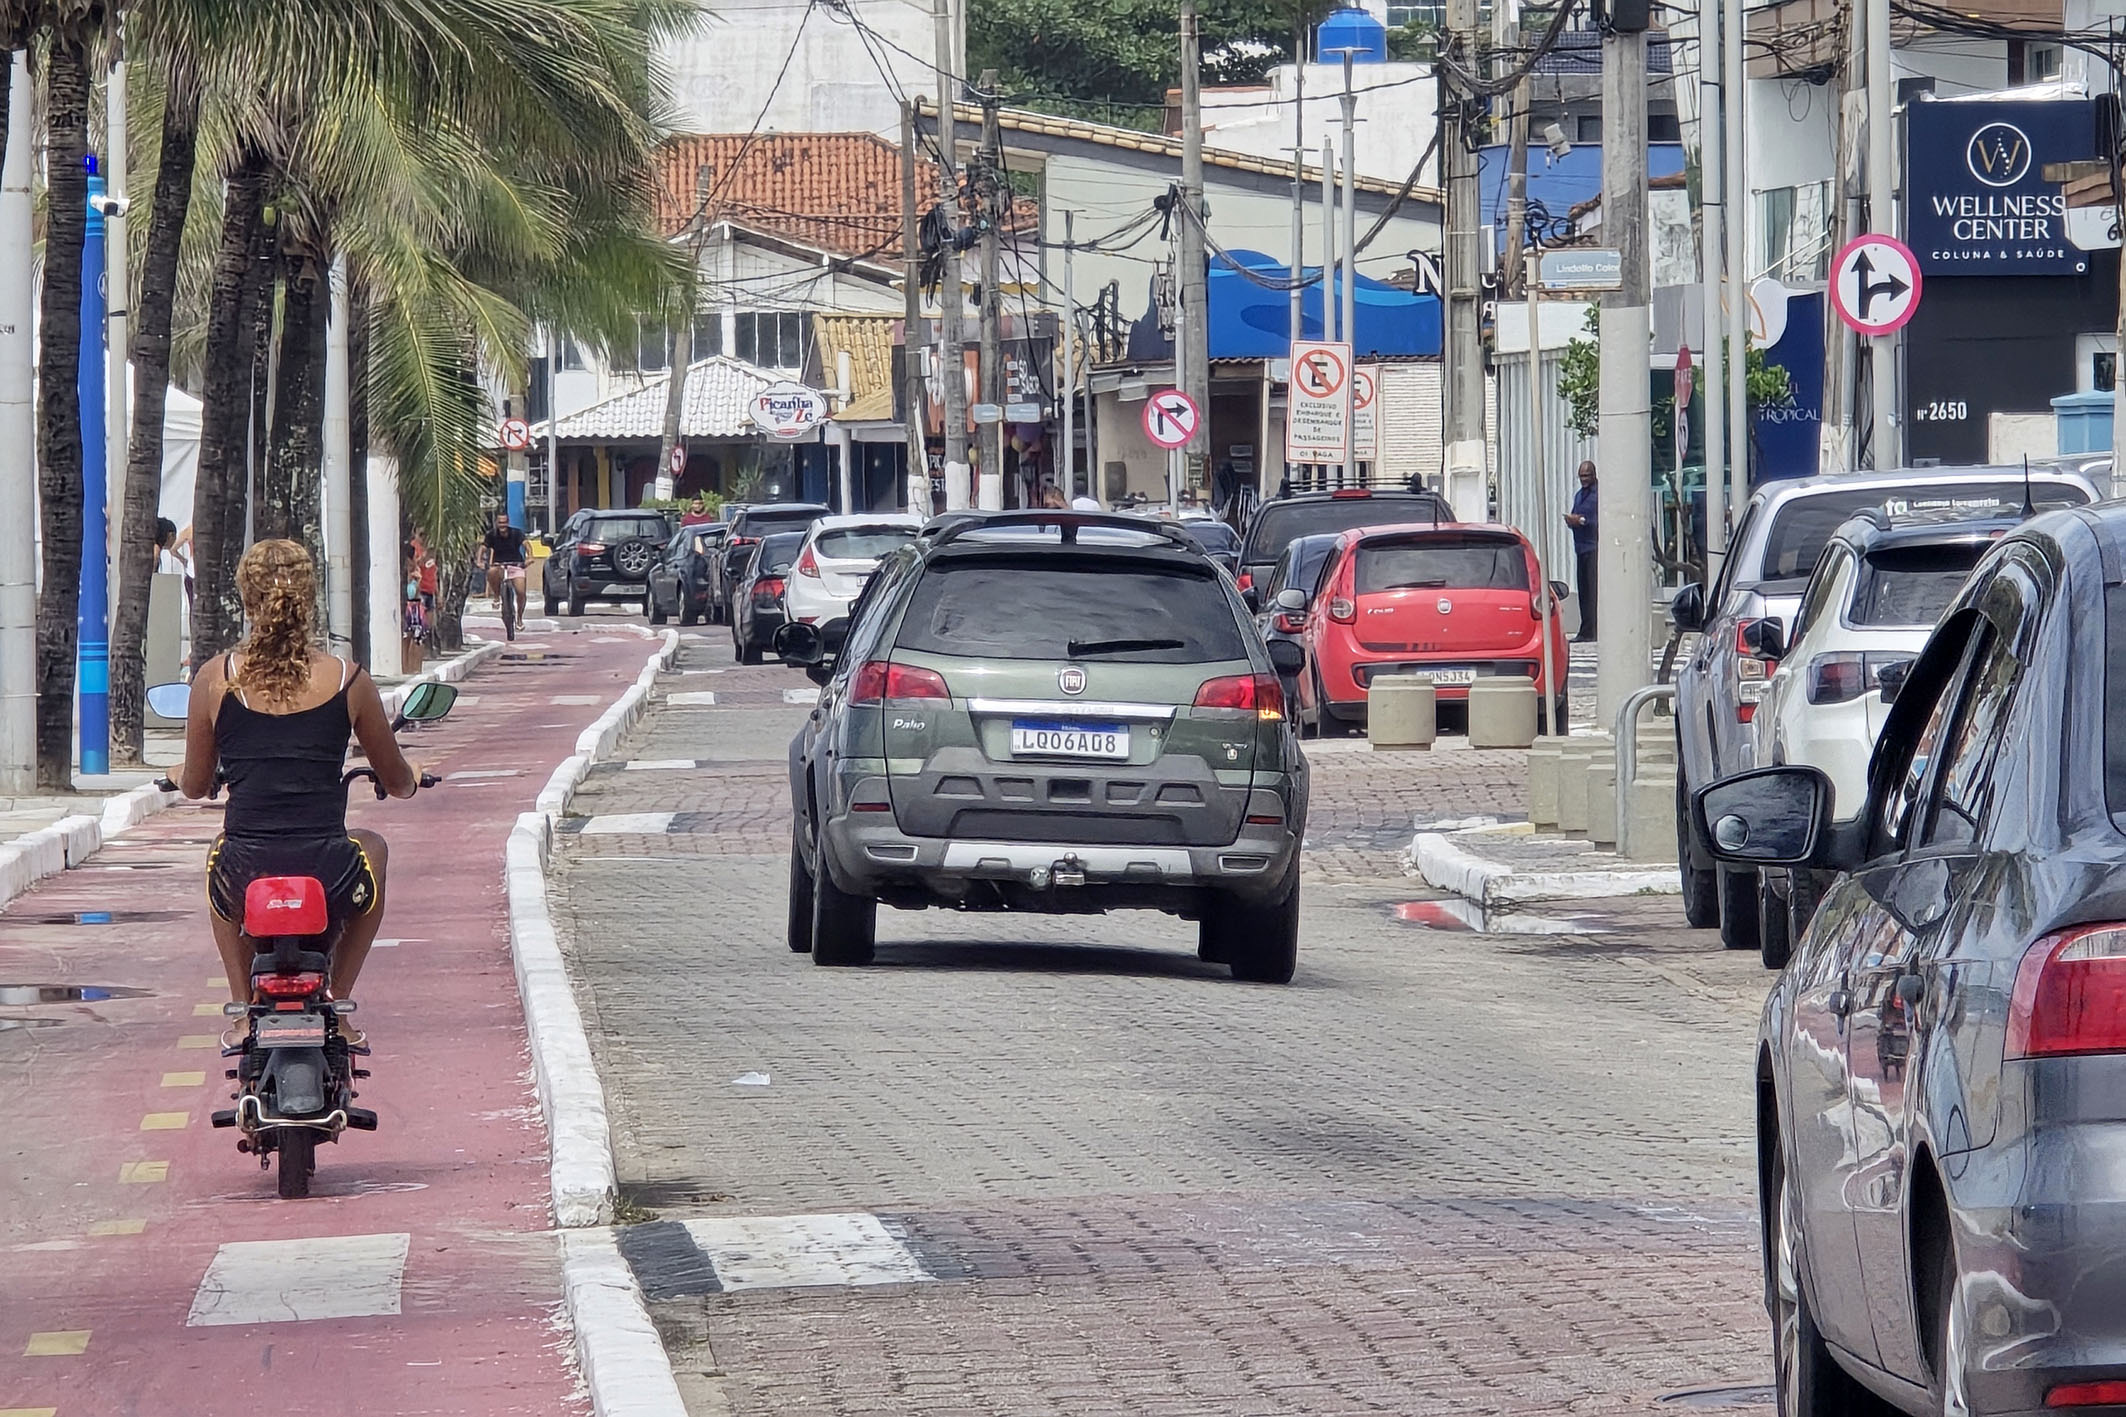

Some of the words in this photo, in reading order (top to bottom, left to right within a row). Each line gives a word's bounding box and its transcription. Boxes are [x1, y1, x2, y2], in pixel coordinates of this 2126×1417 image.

[1932, 195, 2066, 217] WELLNESS
[1953, 218, 2050, 240] CENTER
[1932, 250, 1991, 260] COLUNA
[1999, 250, 2008, 259] &
[2016, 247, 2065, 259] SAÚDE
[1929, 402, 1967, 420] 2650
